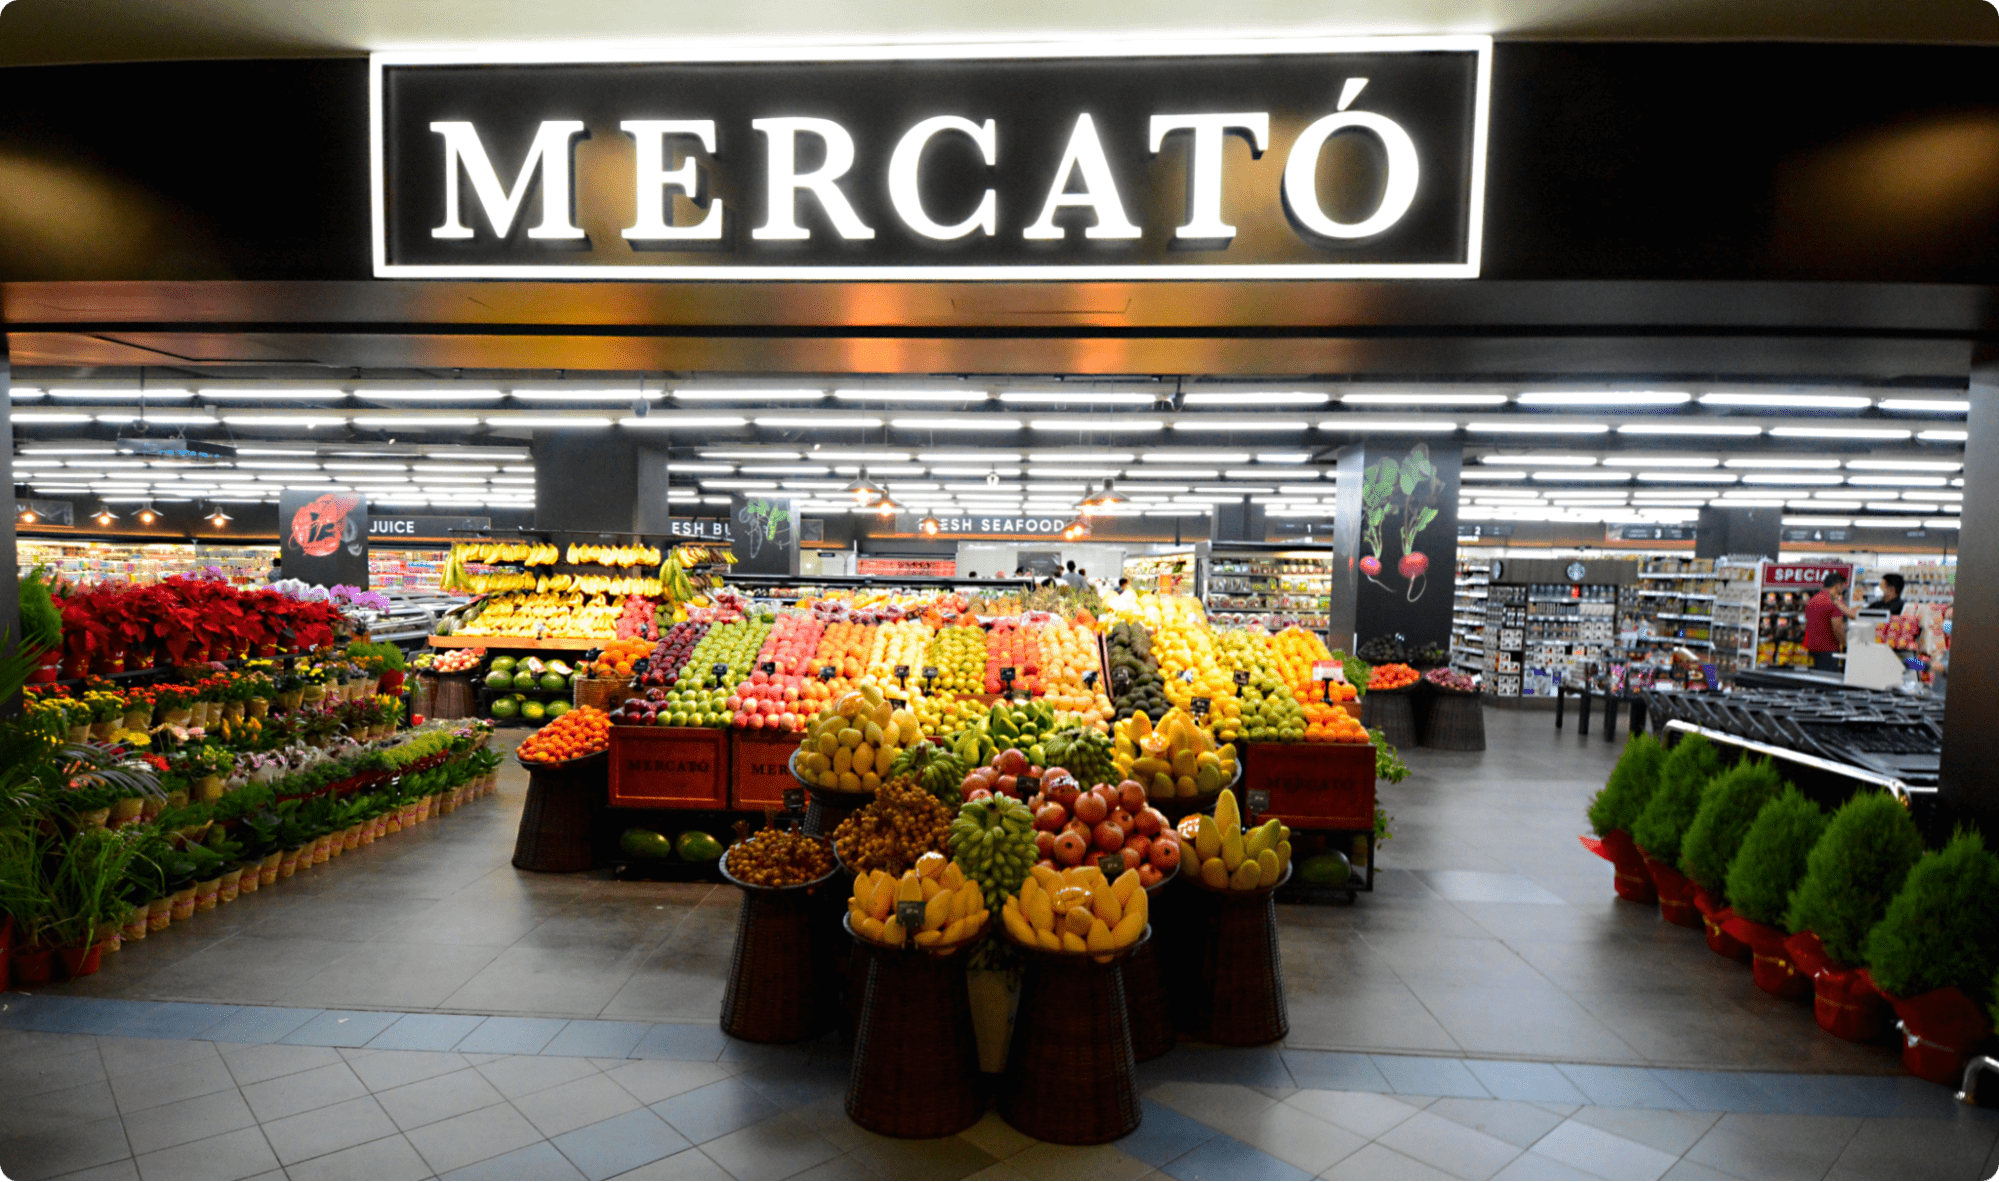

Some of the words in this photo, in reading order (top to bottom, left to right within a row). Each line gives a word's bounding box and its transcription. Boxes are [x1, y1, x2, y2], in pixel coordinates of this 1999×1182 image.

[430, 78, 1420, 240] MERCATÓ
[369, 520, 415, 534] JUICE
[918, 517, 972, 531] FESH
[981, 518, 1064, 532] SEAFOOD
[1306, 523, 1312, 533] 1
[1474, 525, 1481, 536] 2
[1654, 528, 1662, 539] 3
[1775, 567, 1837, 582] SPECIA
